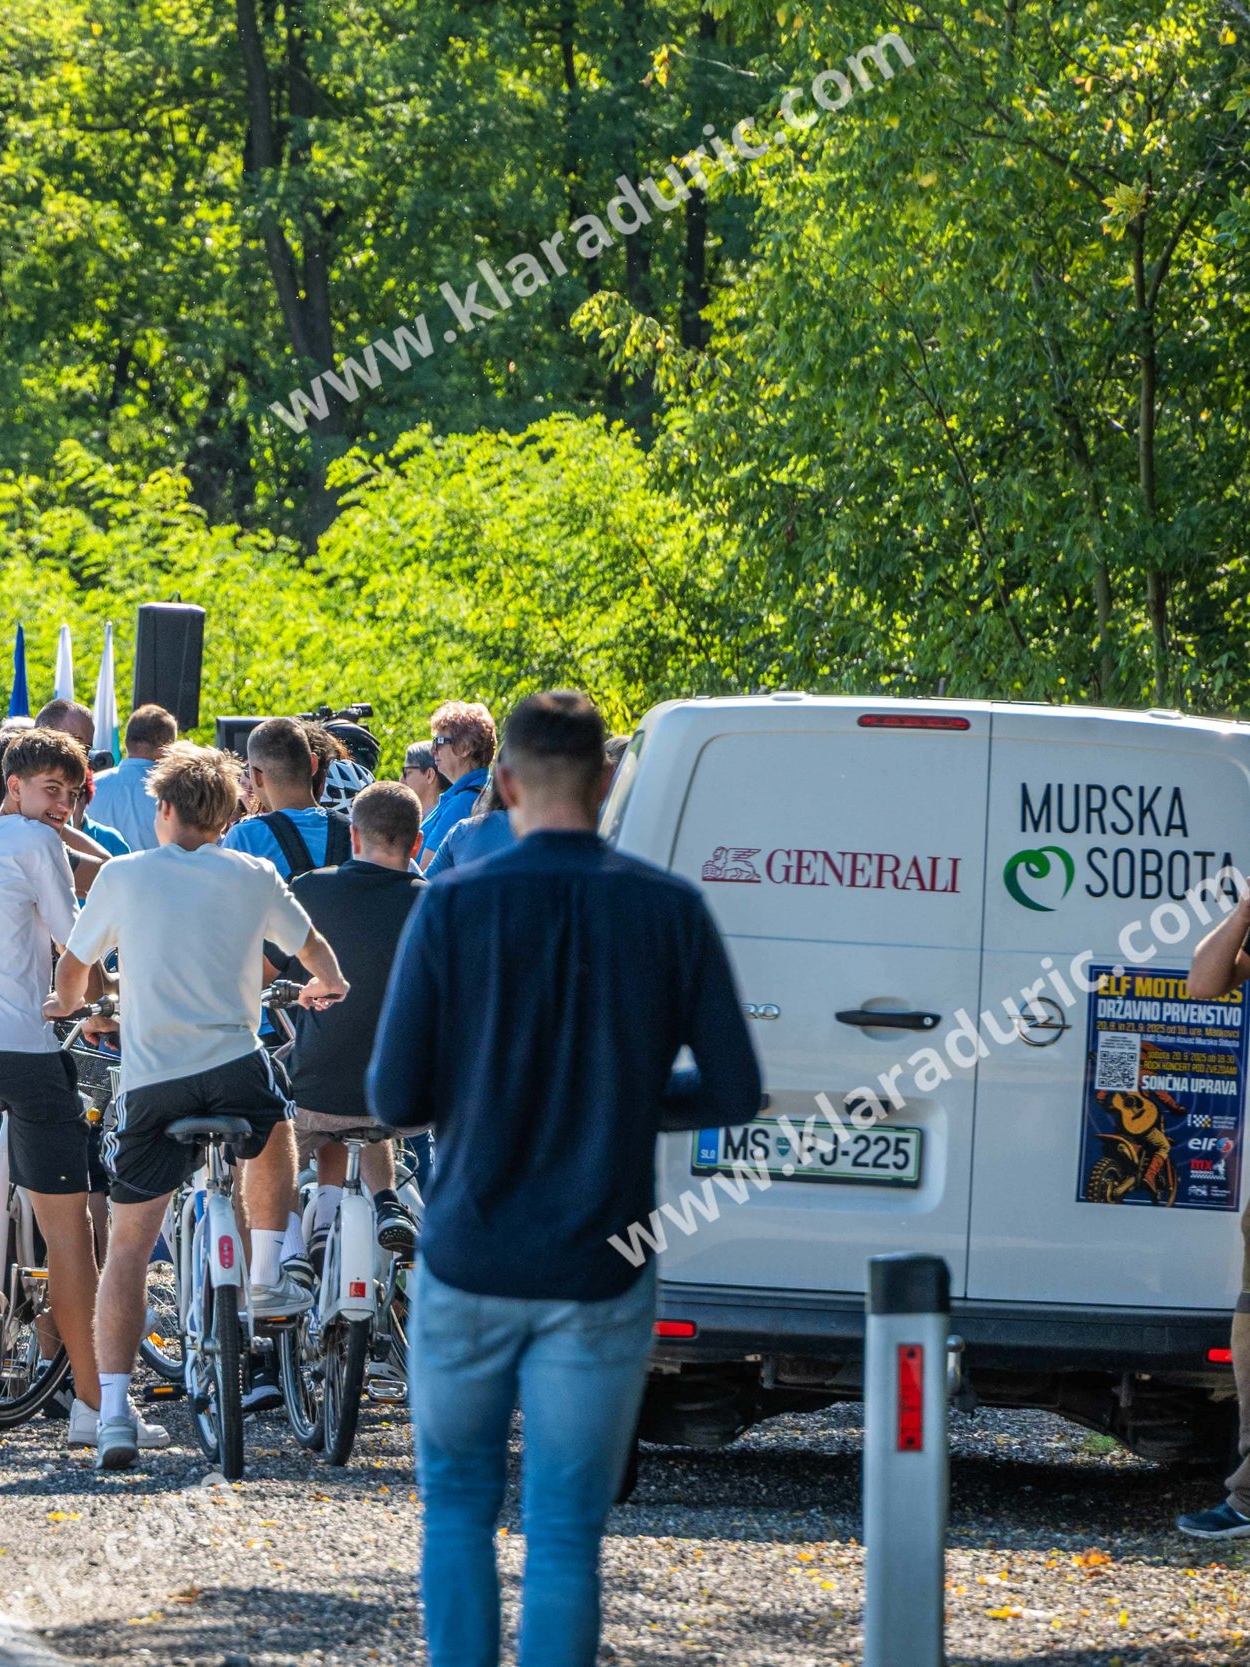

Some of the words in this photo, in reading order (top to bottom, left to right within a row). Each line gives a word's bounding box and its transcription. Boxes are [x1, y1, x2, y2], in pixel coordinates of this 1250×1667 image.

[1021, 782, 1189, 838] MURSKA
[765, 848, 962, 893] GENERALI
[1085, 846, 1239, 904] SOBOTA
[1098, 975, 1131, 996] ELF
[1097, 996, 1161, 1021] DRŽAVNO
[1162, 1001, 1242, 1026] PRVENSTVO
[1141, 1074, 1189, 1092] SONČNA
[1190, 1079, 1237, 1095] UPRAVA
[700, 1150, 716, 1159] SLO
[723, 1127, 770, 1161] MS
[797, 1130, 911, 1171] PJ-225
